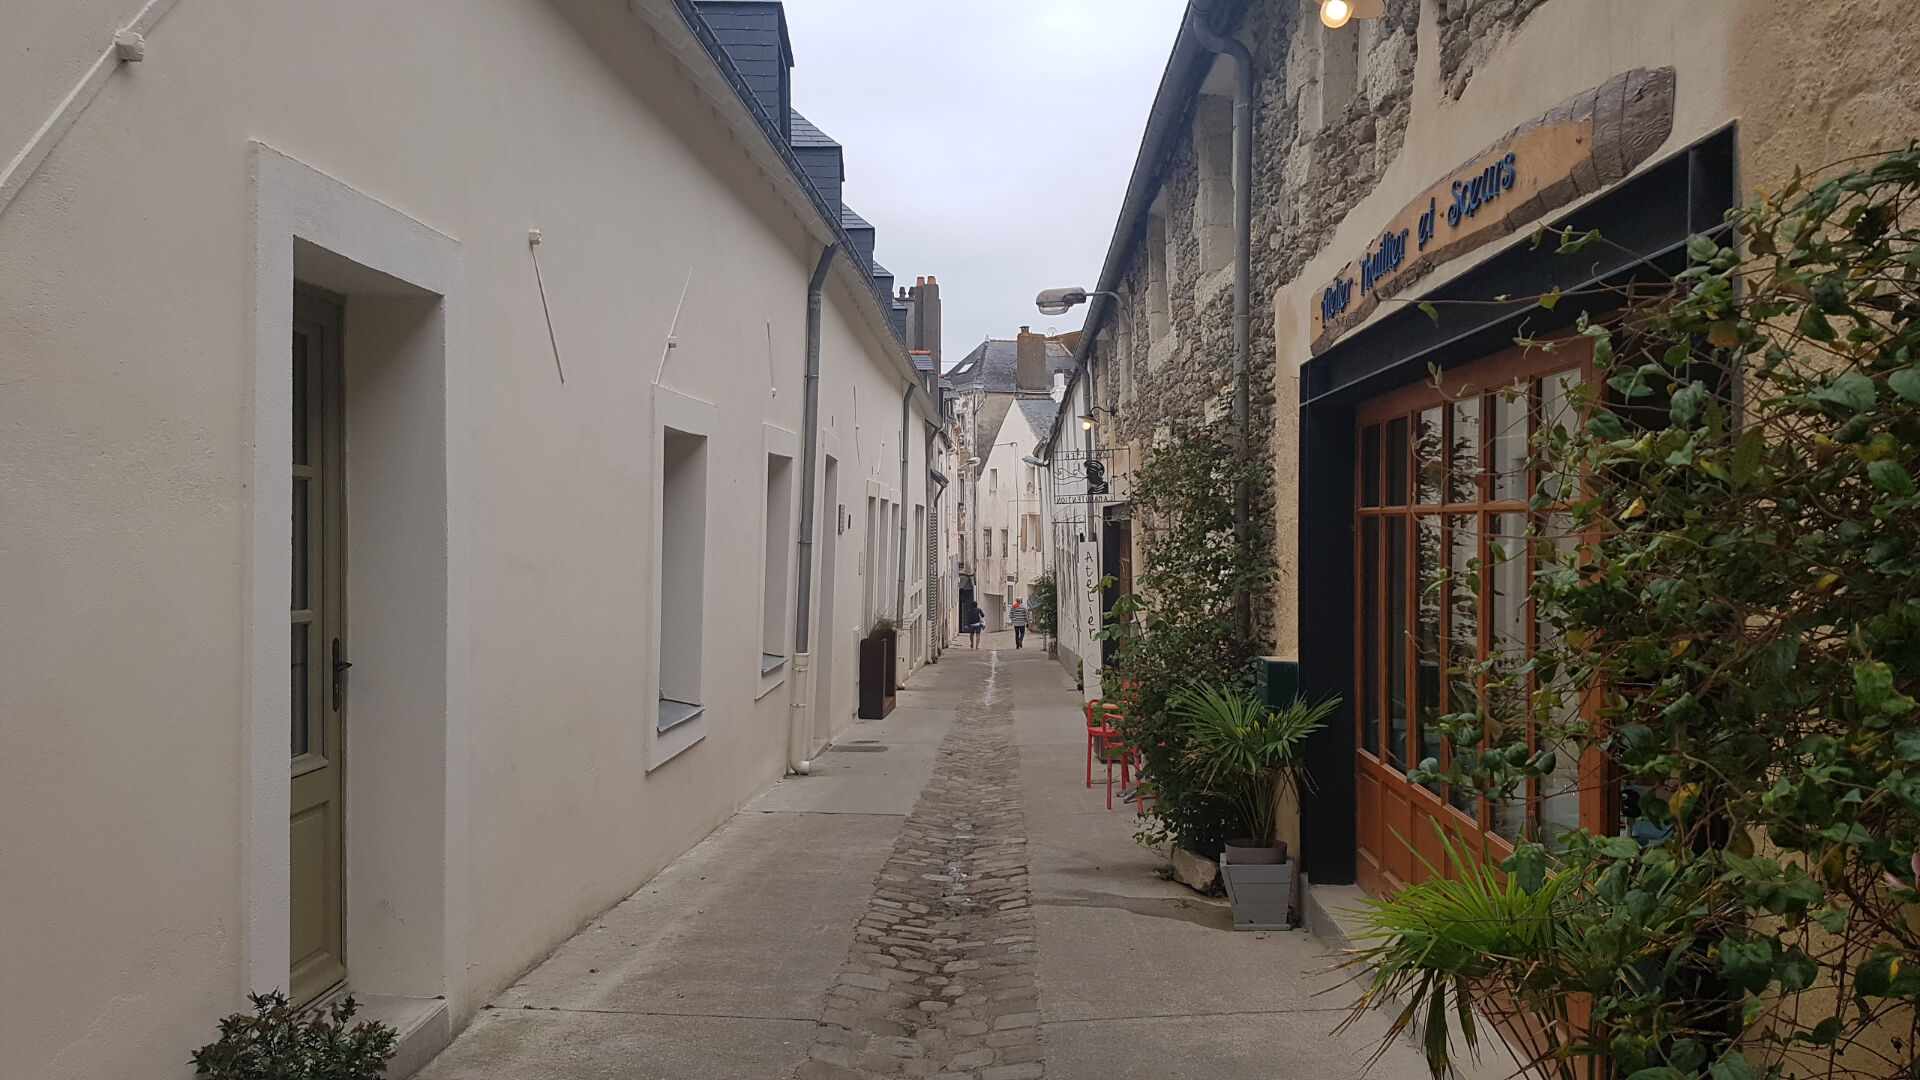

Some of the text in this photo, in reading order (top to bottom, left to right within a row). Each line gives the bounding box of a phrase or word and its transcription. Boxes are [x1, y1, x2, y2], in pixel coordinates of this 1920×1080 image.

[1321, 277, 1354, 328] Atelier
[1418, 197, 1436, 250] et
[1084, 551, 1096, 640] Atelier
